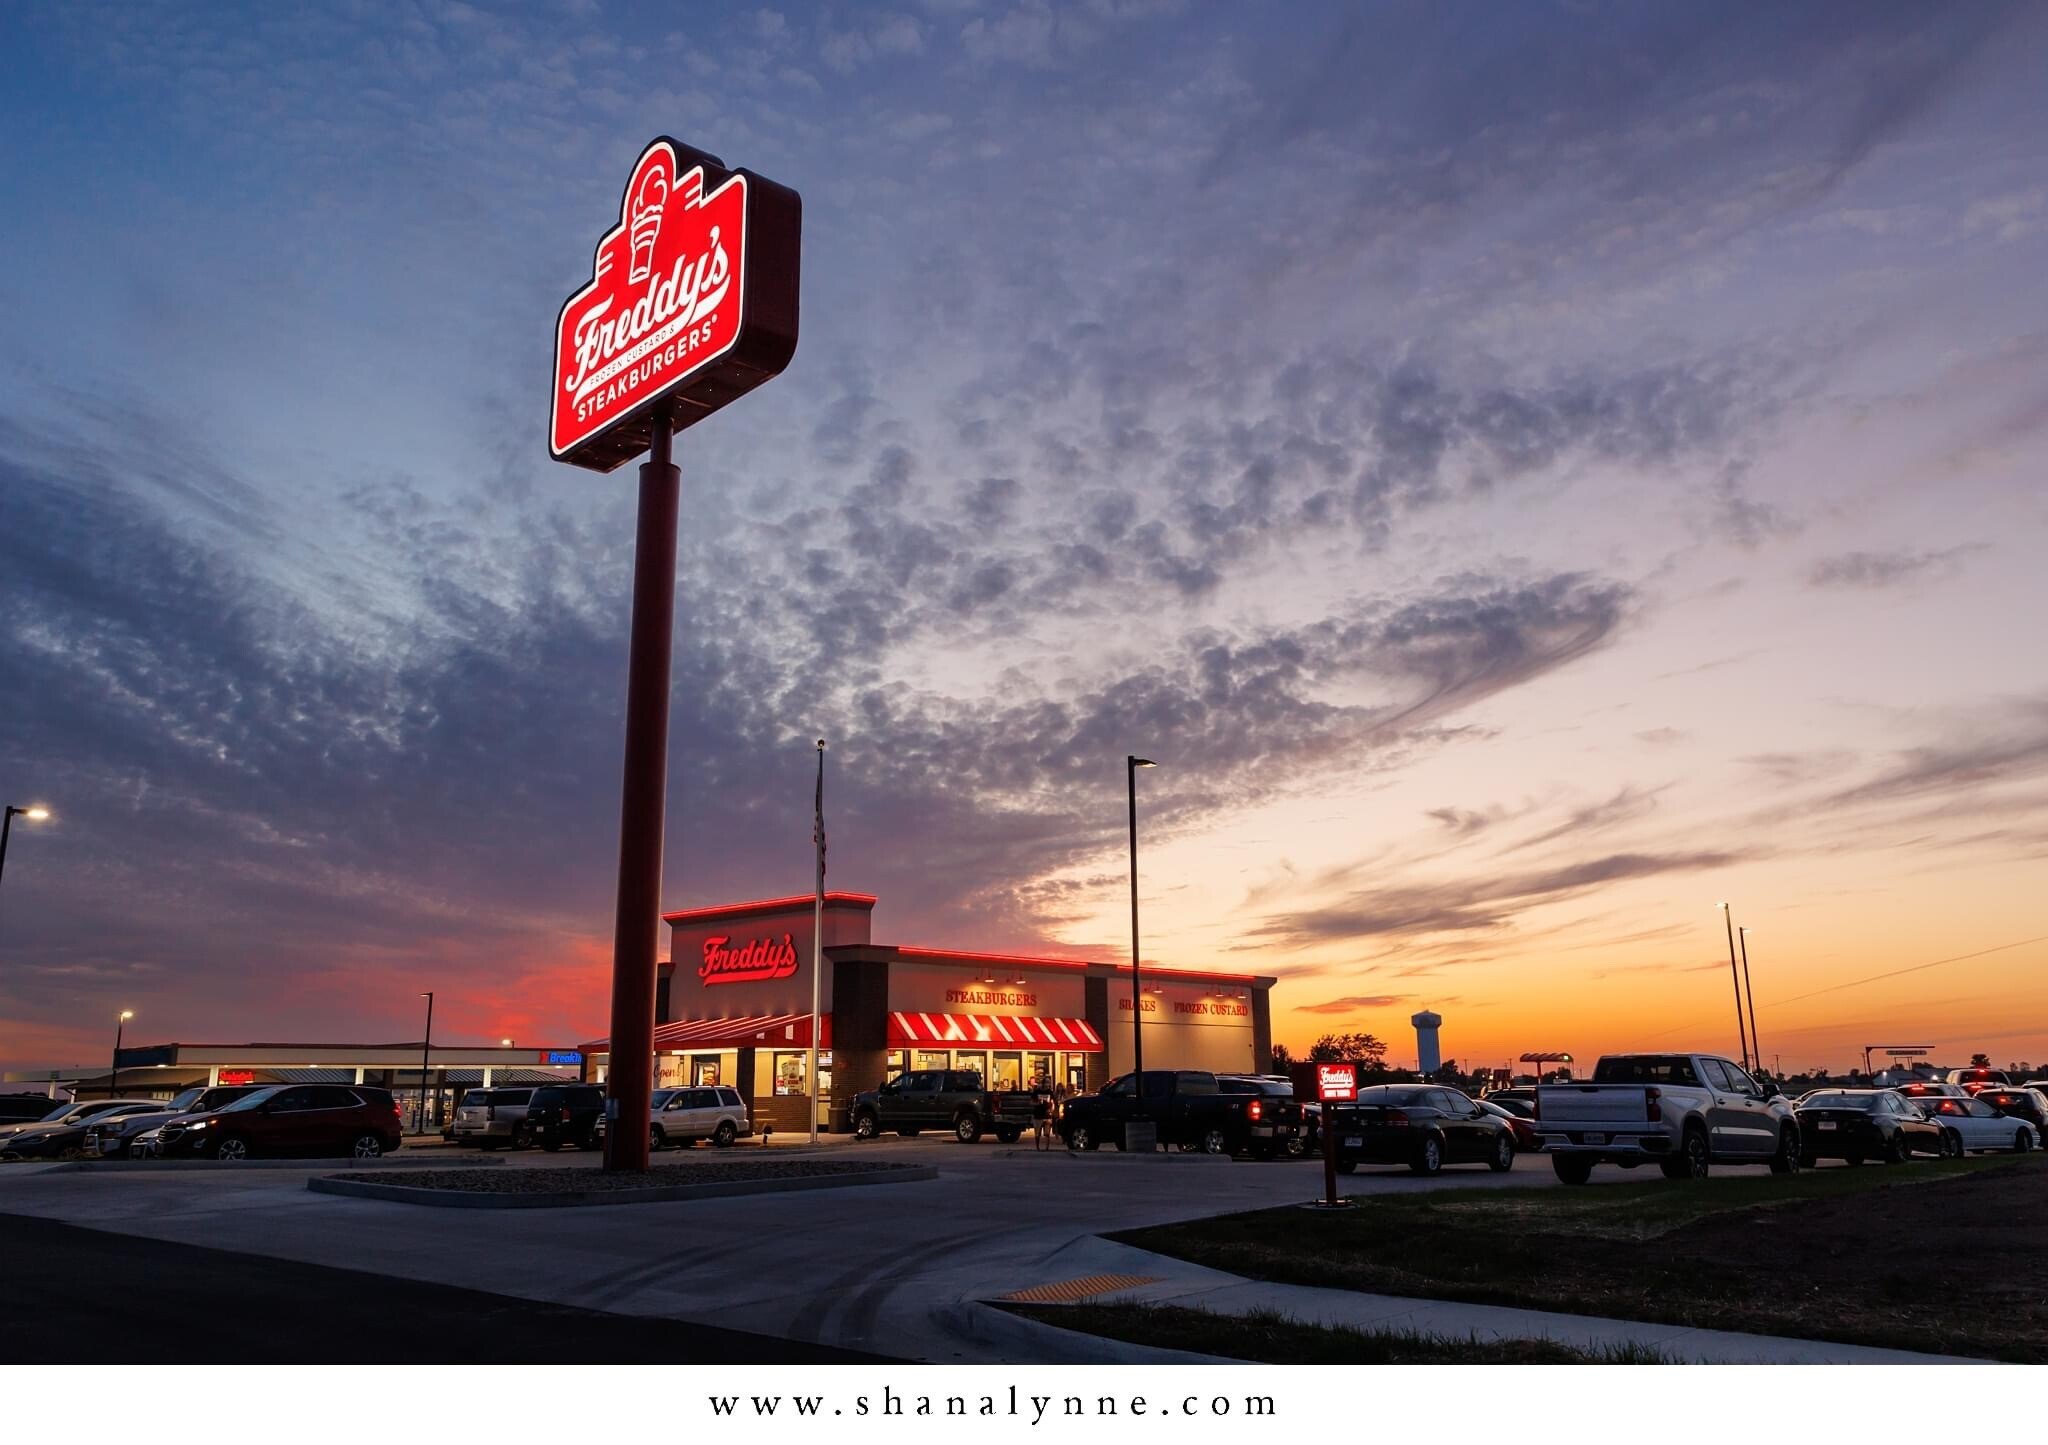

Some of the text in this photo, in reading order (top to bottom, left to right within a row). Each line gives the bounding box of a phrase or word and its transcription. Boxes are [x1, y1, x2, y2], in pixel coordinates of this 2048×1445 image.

[566, 225, 730, 408] Freddy's
[590, 359, 623, 386] FROZEN
[626, 330, 667, 363] CUSTARD
[698, 933, 799, 987] Freddy's
[945, 990, 1037, 1006] STEAKBURGERS
[1174, 1001, 1249, 1017] FROZEN CUSTARD
[1320, 1067, 1354, 1090] Freddy's
